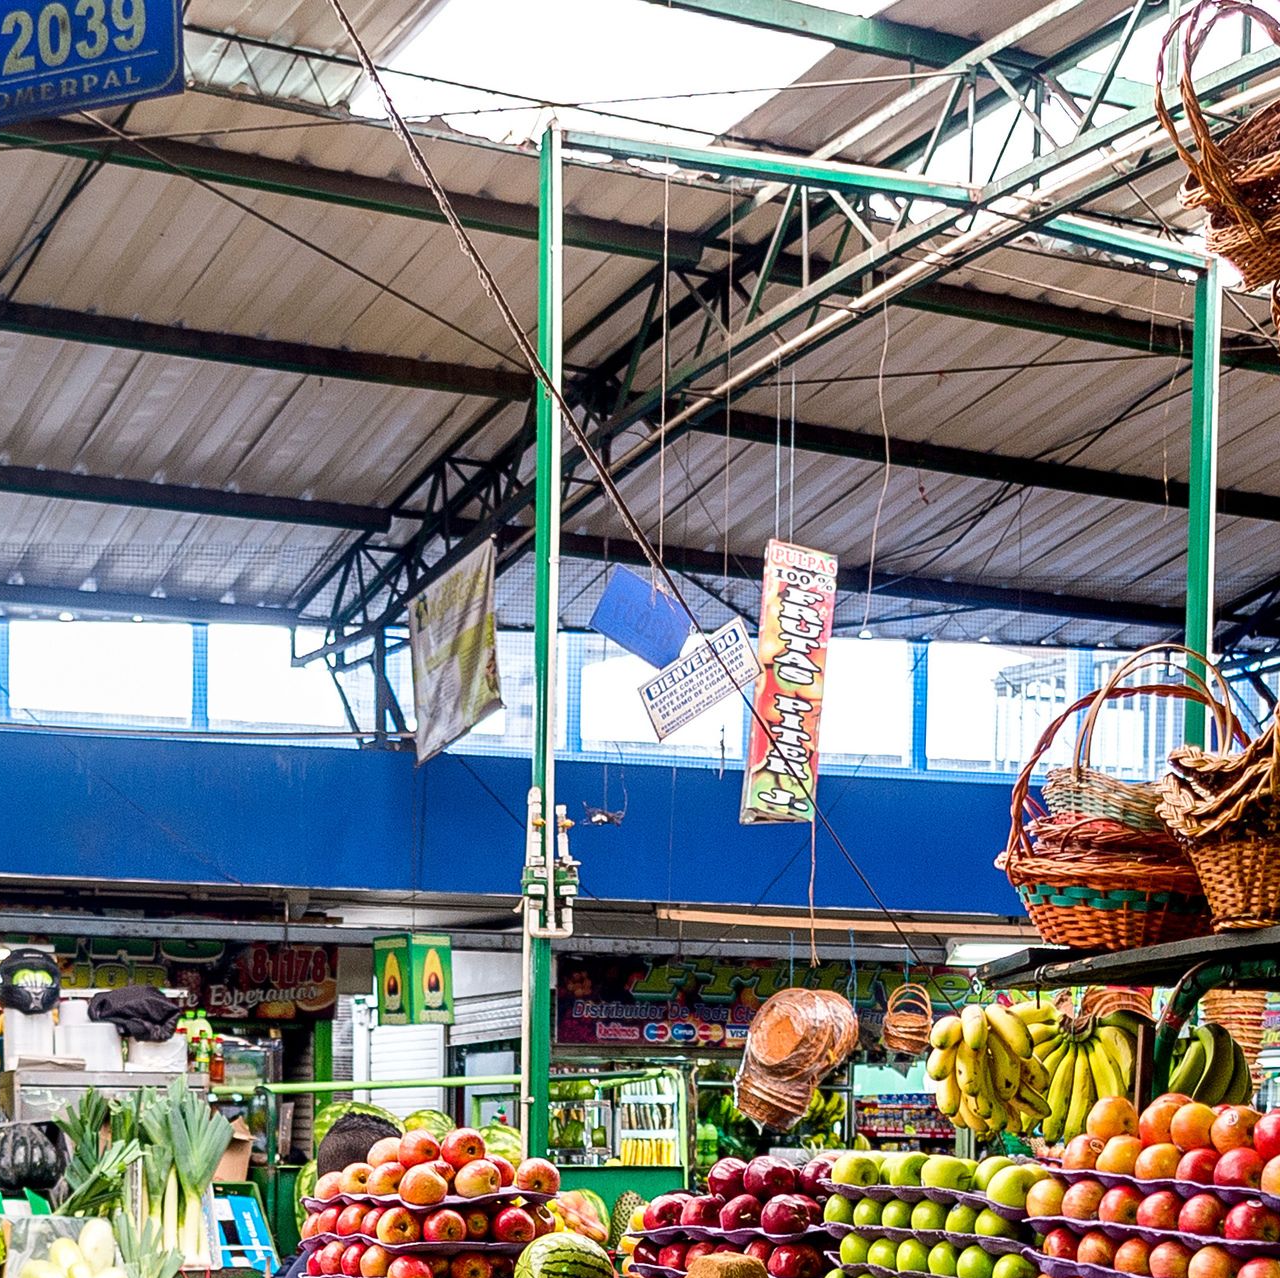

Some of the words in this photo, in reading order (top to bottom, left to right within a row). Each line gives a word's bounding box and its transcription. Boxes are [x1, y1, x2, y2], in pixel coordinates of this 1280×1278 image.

[775, 548, 836, 575] PULPAS
[772, 585, 825, 686] FRUTAS
[648, 629, 739, 698] BIENVENDO
[724, 654, 744, 669] IBRE
[249, 946, 328, 984] 81178
[572, 1000, 666, 1019] Distribuidor
[669, 1003, 689, 1019] De
